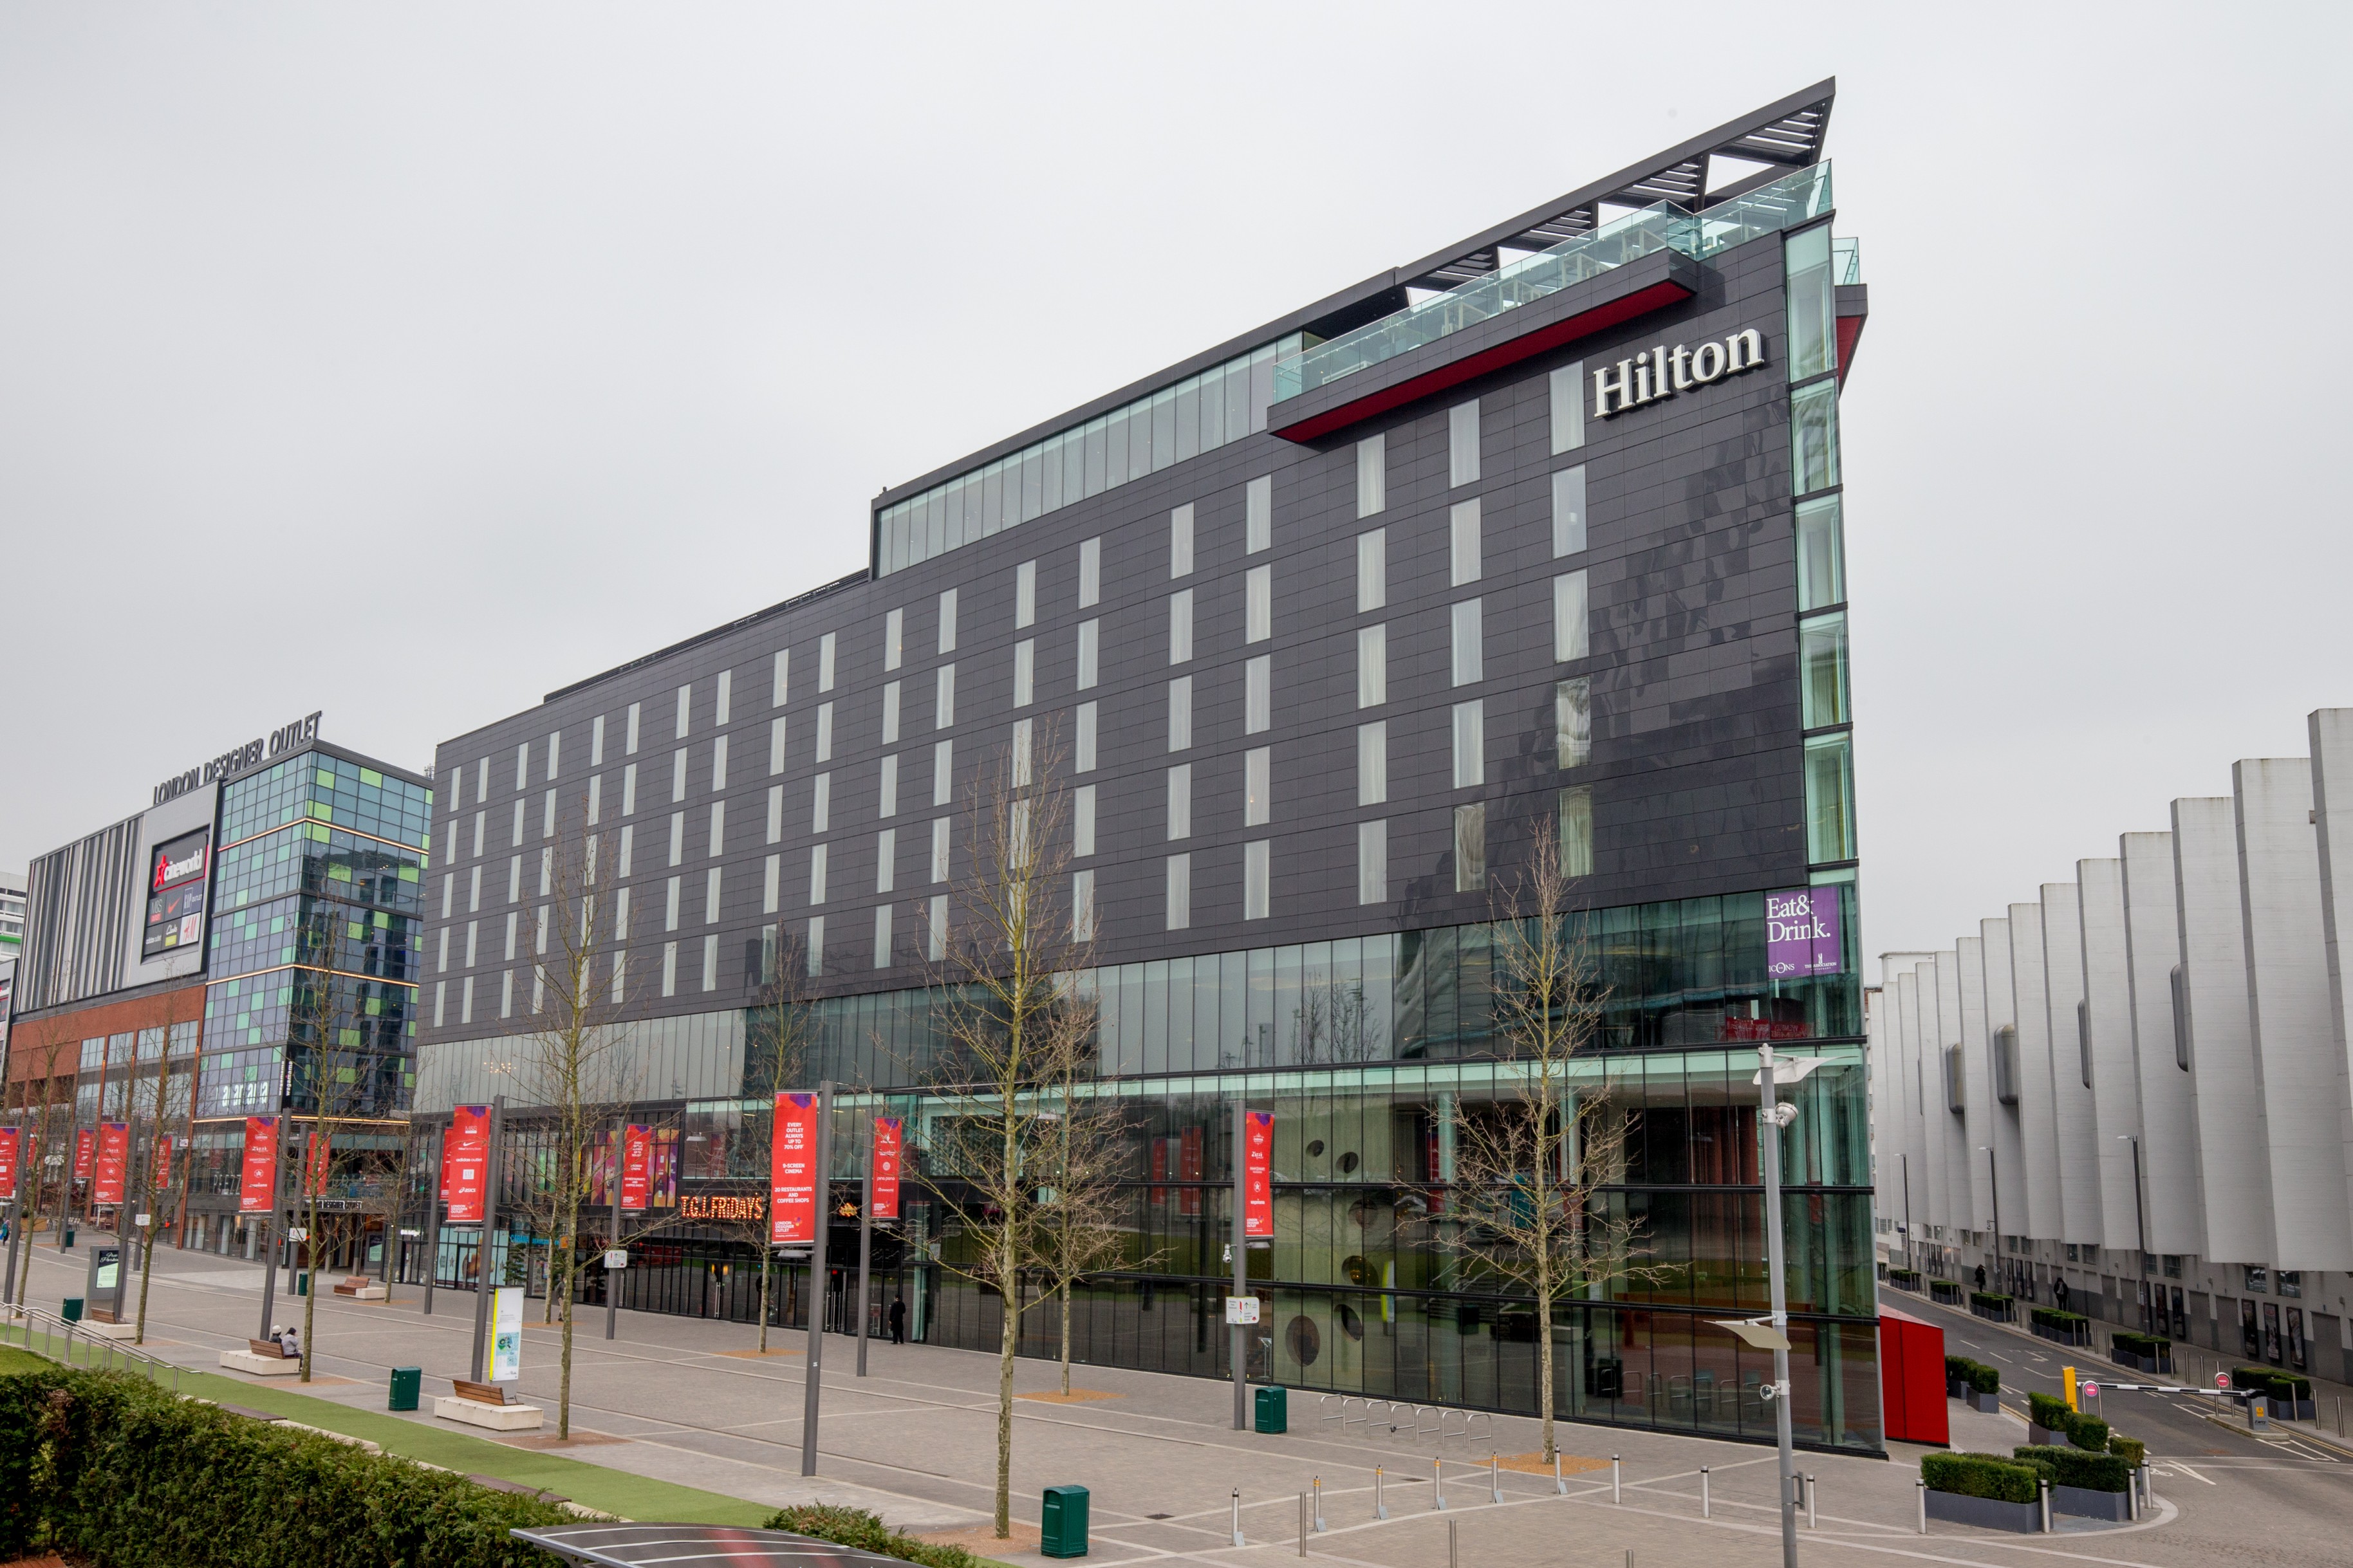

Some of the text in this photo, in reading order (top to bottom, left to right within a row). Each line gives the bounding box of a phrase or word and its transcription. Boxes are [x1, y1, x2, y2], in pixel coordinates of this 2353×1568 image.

[1593, 328, 1765, 418] Hilton
[153, 710, 322, 807] LONDON DESIGNER OUTLET
[163, 848, 203, 881] cineworld
[151, 899, 162, 913] M&S
[1766, 894, 1815, 919] Eat&
[1767, 916, 1831, 943] Drink.
[1769, 962, 1795, 973] ICONS
